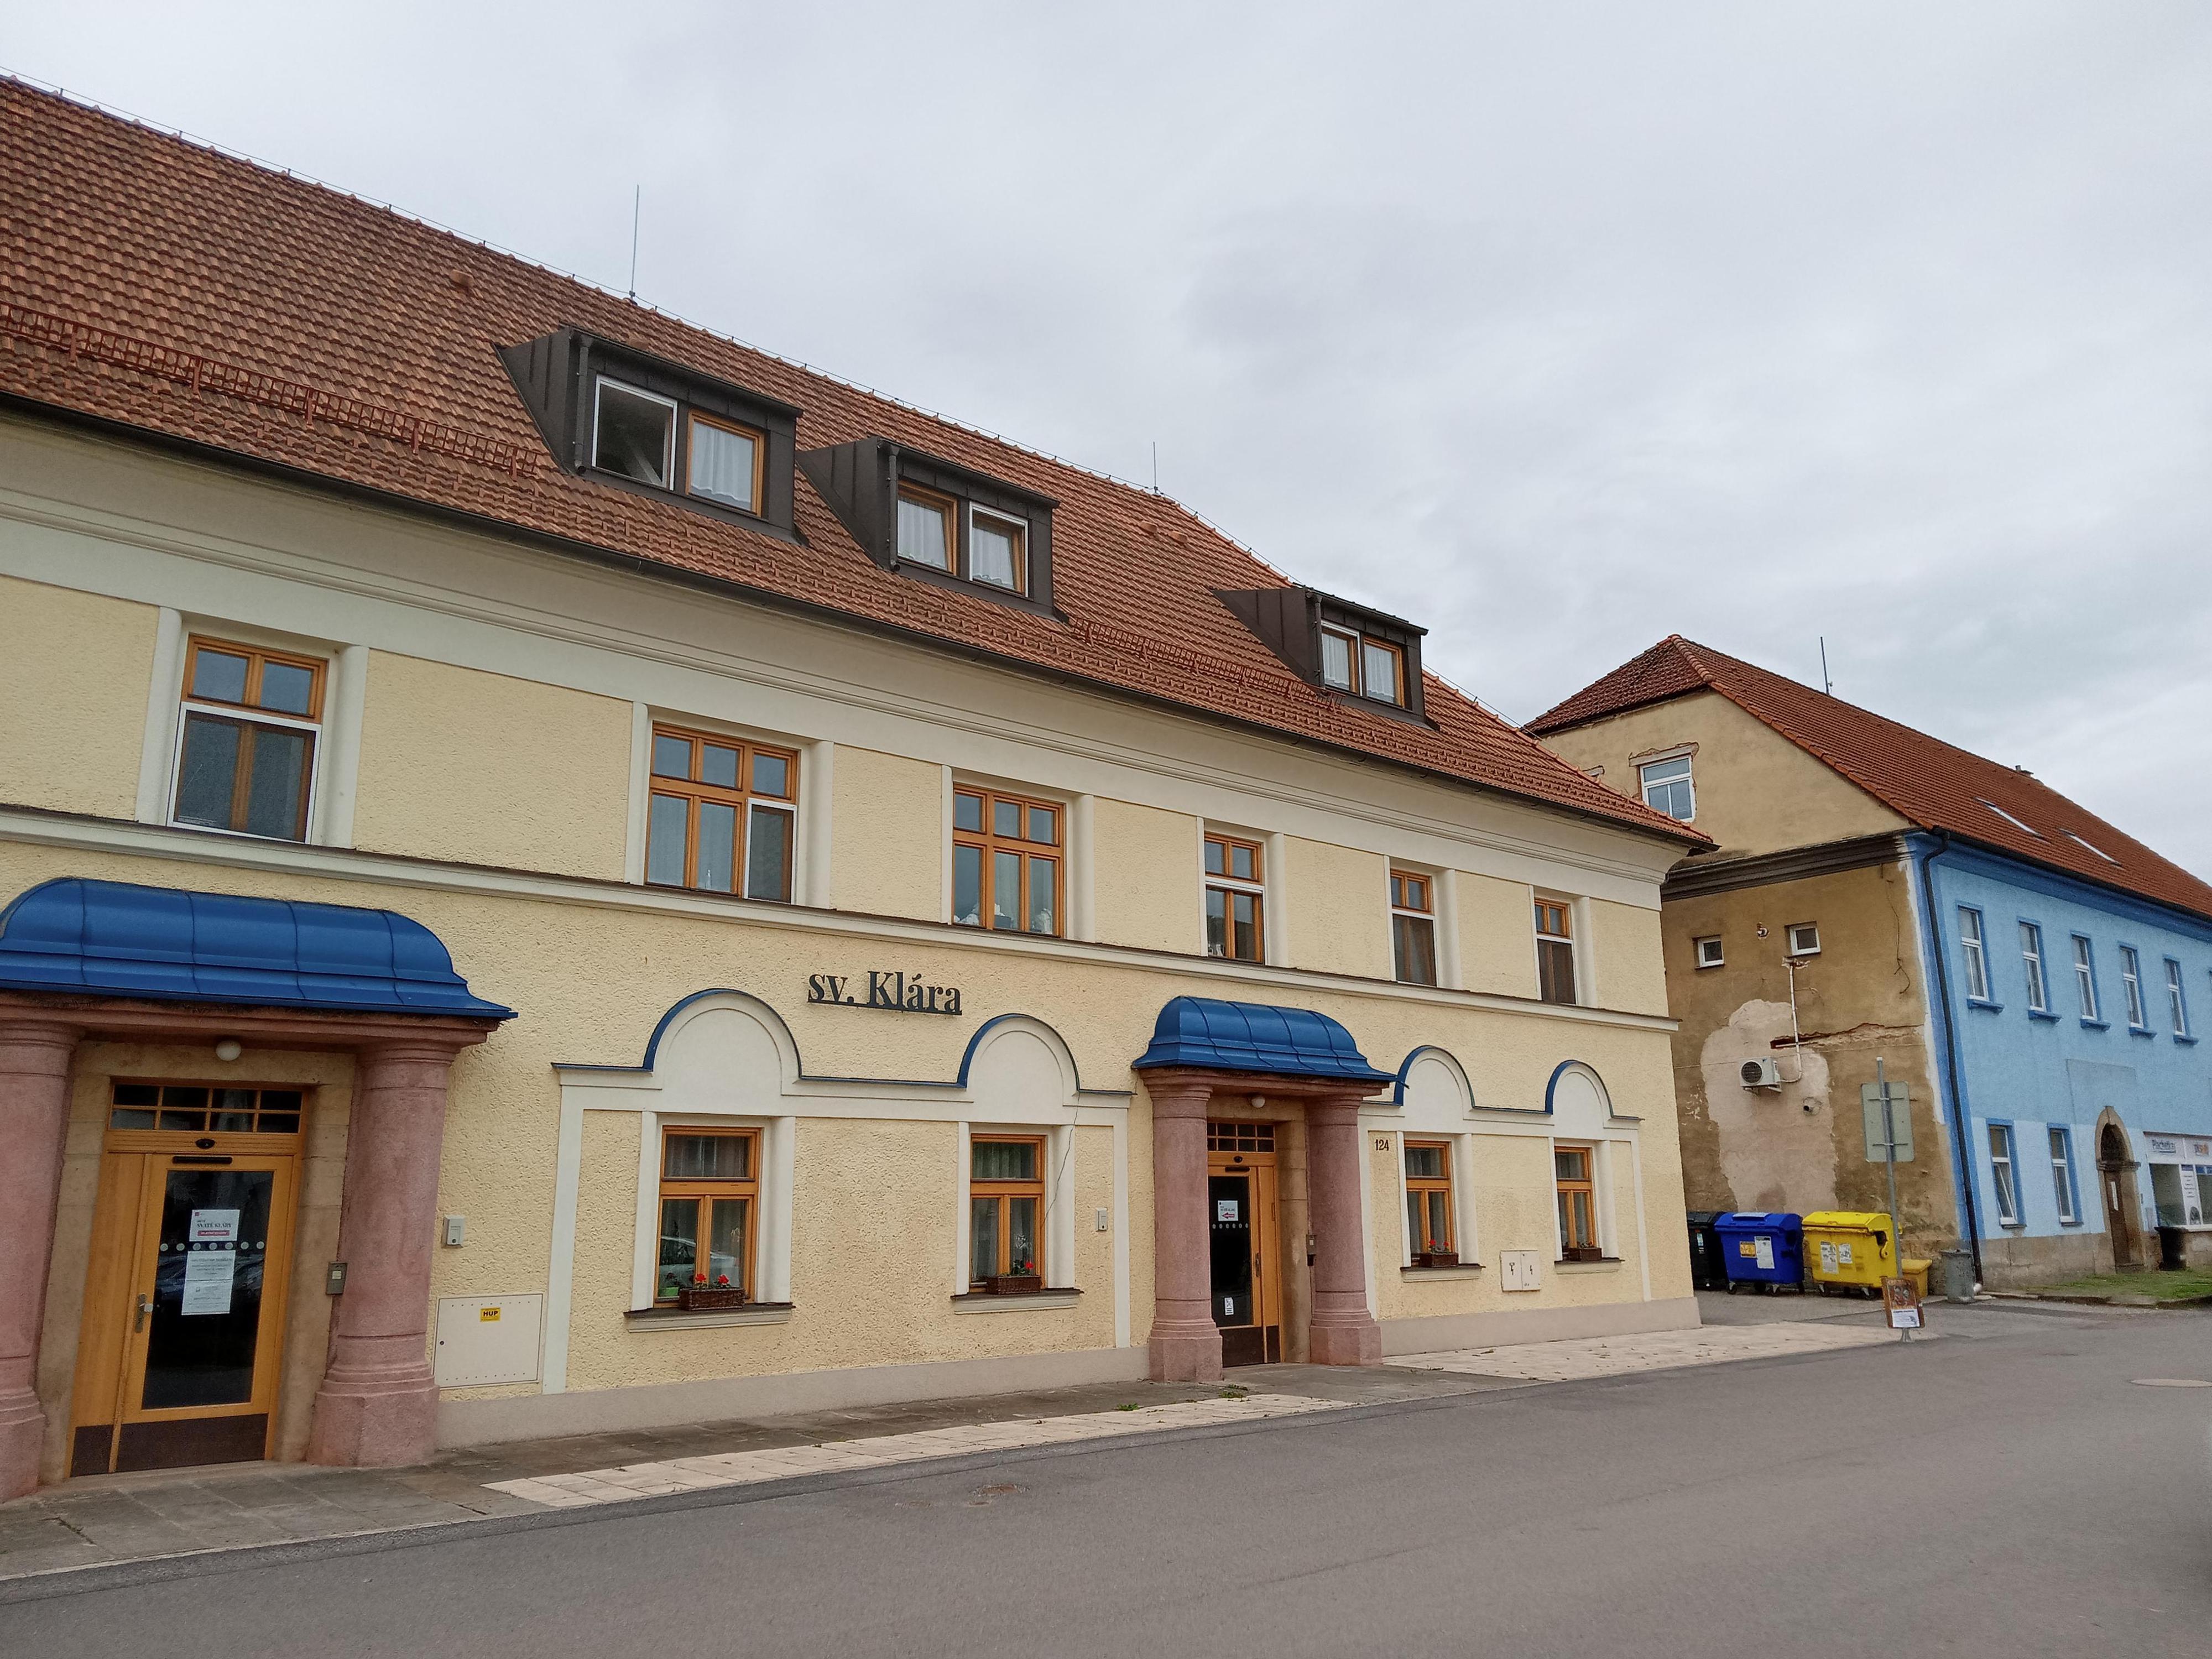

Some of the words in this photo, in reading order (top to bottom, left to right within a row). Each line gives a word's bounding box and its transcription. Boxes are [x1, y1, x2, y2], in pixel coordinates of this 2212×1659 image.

[808, 974, 855, 1004] sv.
[866, 971, 962, 1015] Klára
[1375, 1139, 1389, 1151] 124
